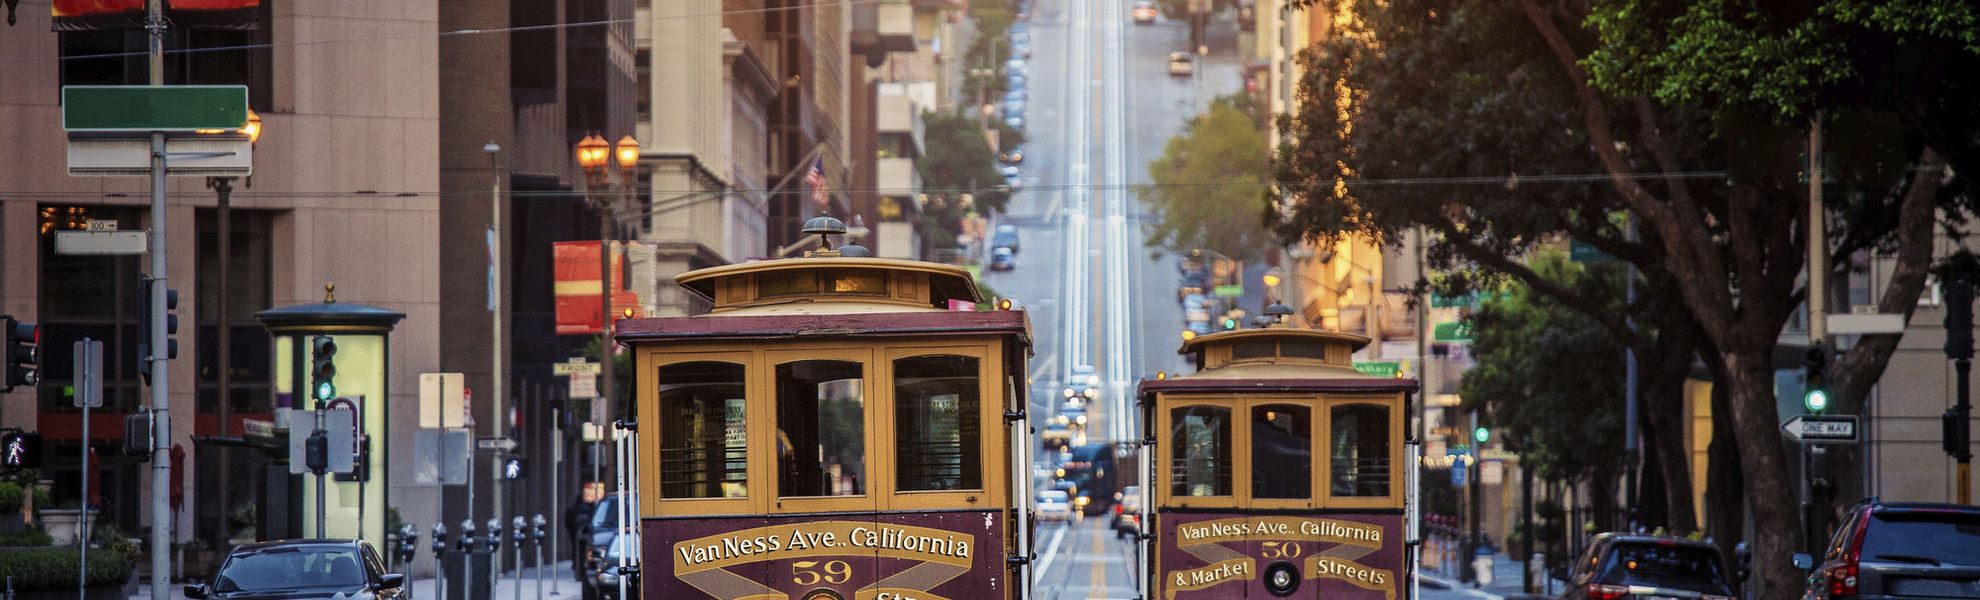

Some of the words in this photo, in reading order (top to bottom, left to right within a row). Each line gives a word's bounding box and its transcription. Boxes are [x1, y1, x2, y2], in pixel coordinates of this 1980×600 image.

[91, 221, 105, 230] 100
[562, 364, 593, 372] FRONT
[1802, 422, 1824, 433] ONE
[1826, 423, 1848, 432] WAY
[1182, 526, 1210, 540] Van
[1211, 521, 1251, 537] Ness
[1300, 520, 1381, 542] California
[680, 545, 721, 566] Van
[722, 534, 781, 559] Ness
[850, 526, 969, 560] California
[1262, 541, 1301, 558] 50
[792, 560, 852, 586] 59
[1176, 572, 1188, 587] &
[1191, 560, 1249, 586] Market
[1318, 559, 1385, 585] Streets
